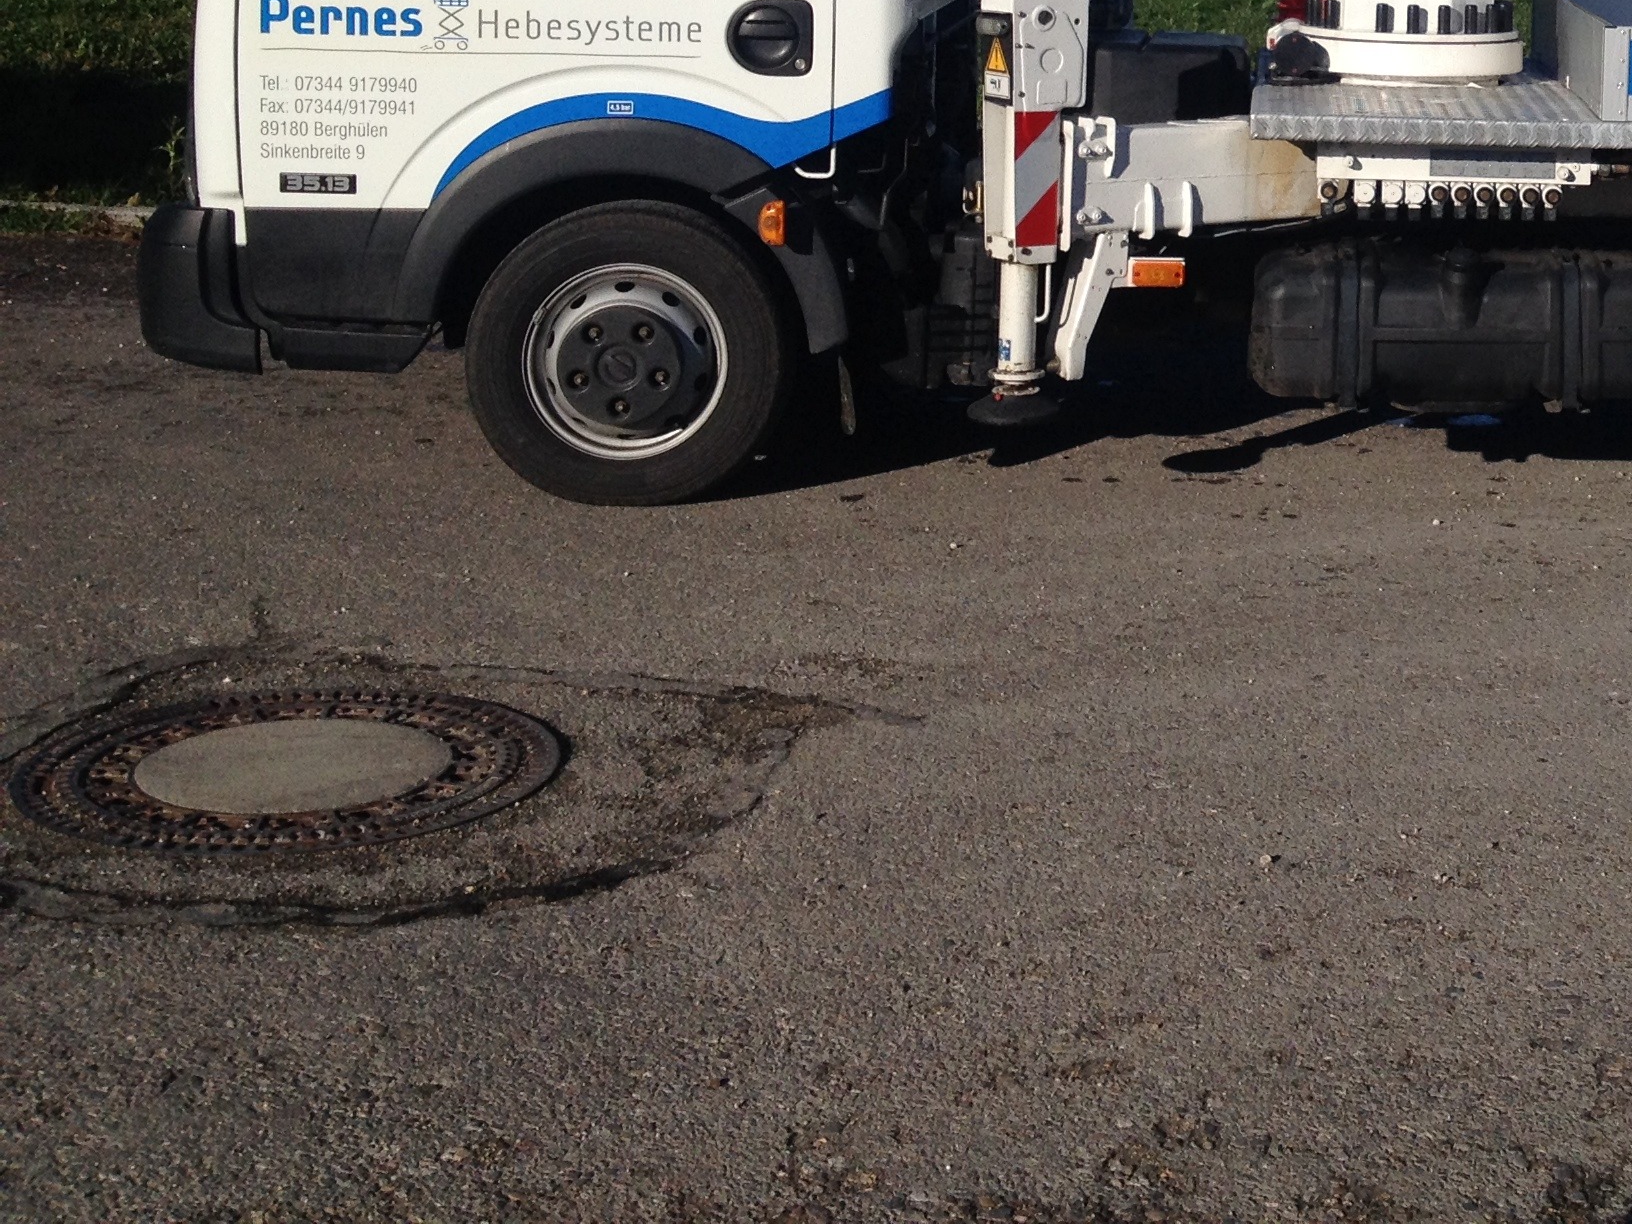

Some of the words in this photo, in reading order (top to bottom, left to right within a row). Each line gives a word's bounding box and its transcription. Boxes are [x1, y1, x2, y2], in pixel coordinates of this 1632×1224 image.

[477, 8, 702, 45] Hebesysteme
[294, 76, 343, 92] 07344
[349, 76, 417, 93] 9179940
[260, 97, 289, 114] Fax:
[294, 98, 415, 116] 07344/9179941
[260, 121, 309, 136] 89180
[314, 121, 388, 140] Berghülen
[260, 143, 351, 159] Sinkenbreite
[356, 144, 366, 160] 9
[286, 175, 350, 192] 35.13
